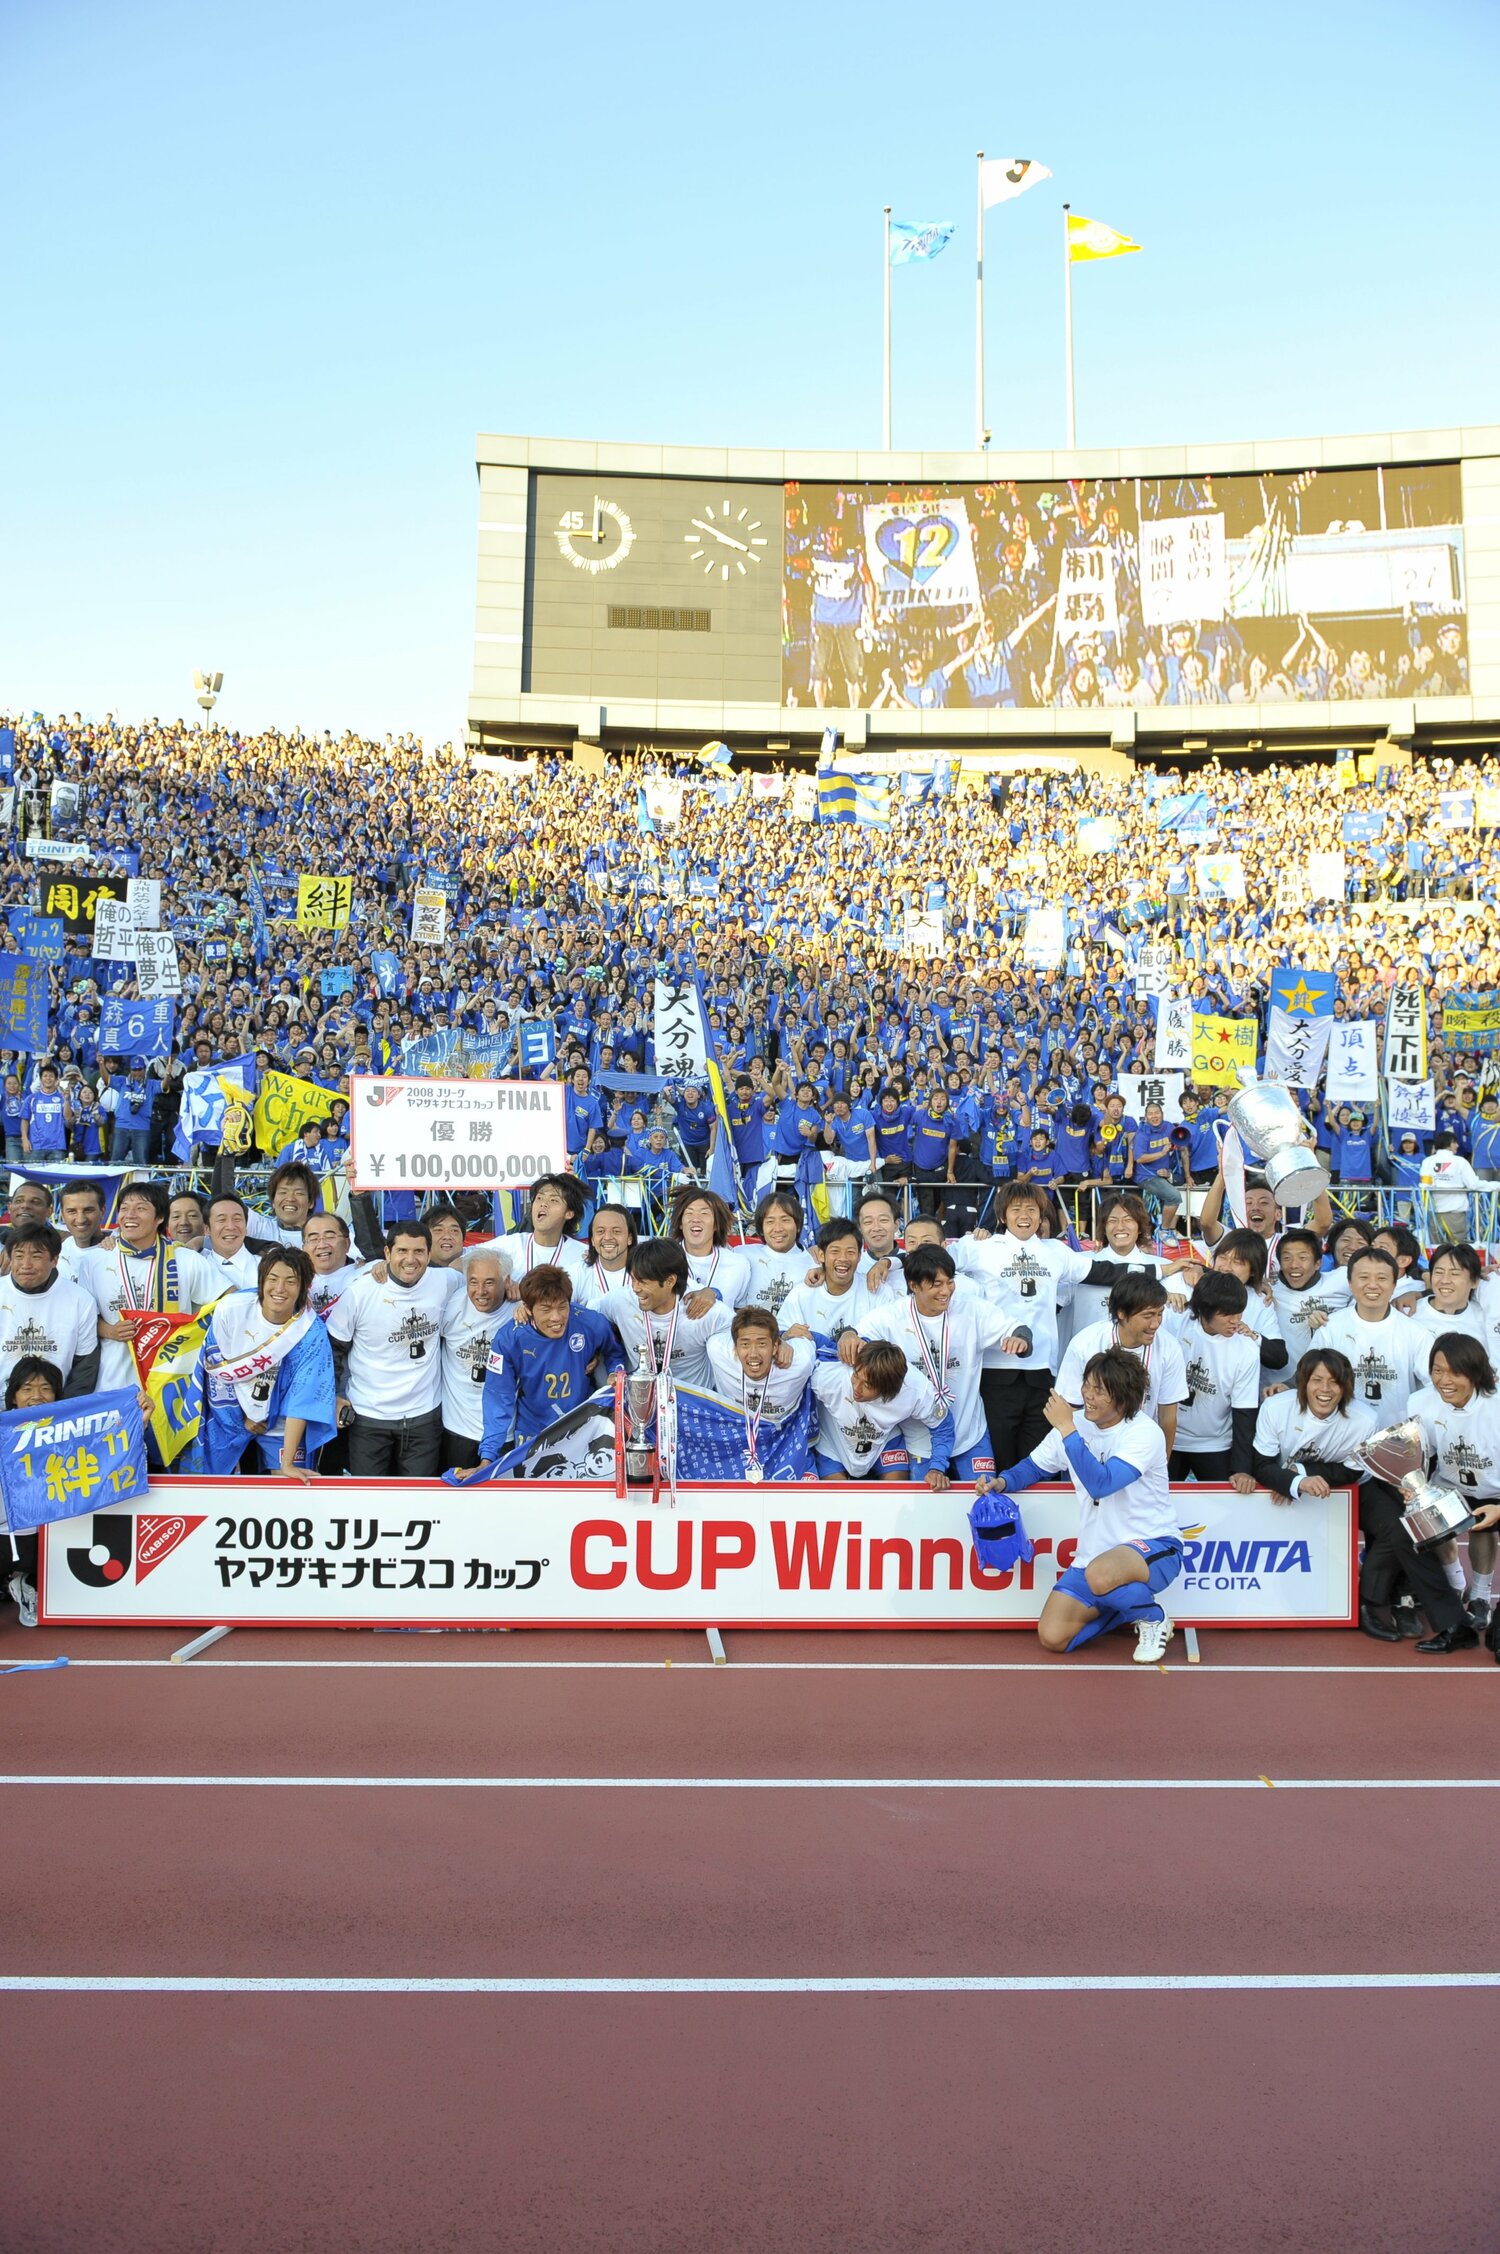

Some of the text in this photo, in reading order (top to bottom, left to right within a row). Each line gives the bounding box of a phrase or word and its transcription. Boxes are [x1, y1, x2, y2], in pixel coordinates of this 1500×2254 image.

[559, 511, 584, 529] 45
[893, 524, 949, 567] 12
[29, 845, 86, 856] TRINITA
[100, 902, 132, 923] 俺の
[304, 880, 348, 928] 絆
[97, 926, 134, 957] 哲平
[135, 934, 174, 956] 俺の
[1138, 949, 1169, 969] 俺の
[137, 957, 181, 992] 夢生
[1137, 973, 1170, 993] エジ
[127, 1014, 145, 1038] 6
[659, 985, 698, 1078] 大分魂
[1389, 988, 1421, 1074] 死守下川
[1340, 1027, 1367, 1077] 頂点
[265, 1076, 295, 1097] We
[406, 1087, 466, 1099] 2008 Jリーグ
[407, 1098, 496, 1110] ヤマザキナビスコ カップ
[497, 1089, 552, 1112] FINAL
[45, 1113, 52, 1123] 9
[430, 1120, 493, 1142] 優勝
[395, 1153, 551, 1183] 100,000,000
[1018, 1270, 1052, 1278] WINNERS
[756, 1293, 770, 1301] CUP
[388, 1325, 440, 1343] CUP WINNERS
[20, 1344, 58, 1352] WINNERS
[455, 1351, 471, 1360] CUP
[218, 1354, 273, 1382] 本日の
[1364, 1372, 1398, 1380] WINNERS
[545, 1372, 571, 1399] 22
[12, 1410, 123, 1454] TRINITA
[103, 1429, 130, 1457] 11
[19, 1453, 32, 1478] 1
[45, 1446, 101, 1503] 絆
[107, 1465, 137, 1493] 12
[141, 1521, 182, 1561] NABISCO
[214, 1516, 441, 1551] 2008 Jリーグ
[569, 1519, 756, 1591] CUP
[1181, 1540, 1312, 1574] RINITA
[214, 1556, 550, 1590] ヤマザキナビスコ カップ
[1184, 1577, 1261, 1590] FC OITA
